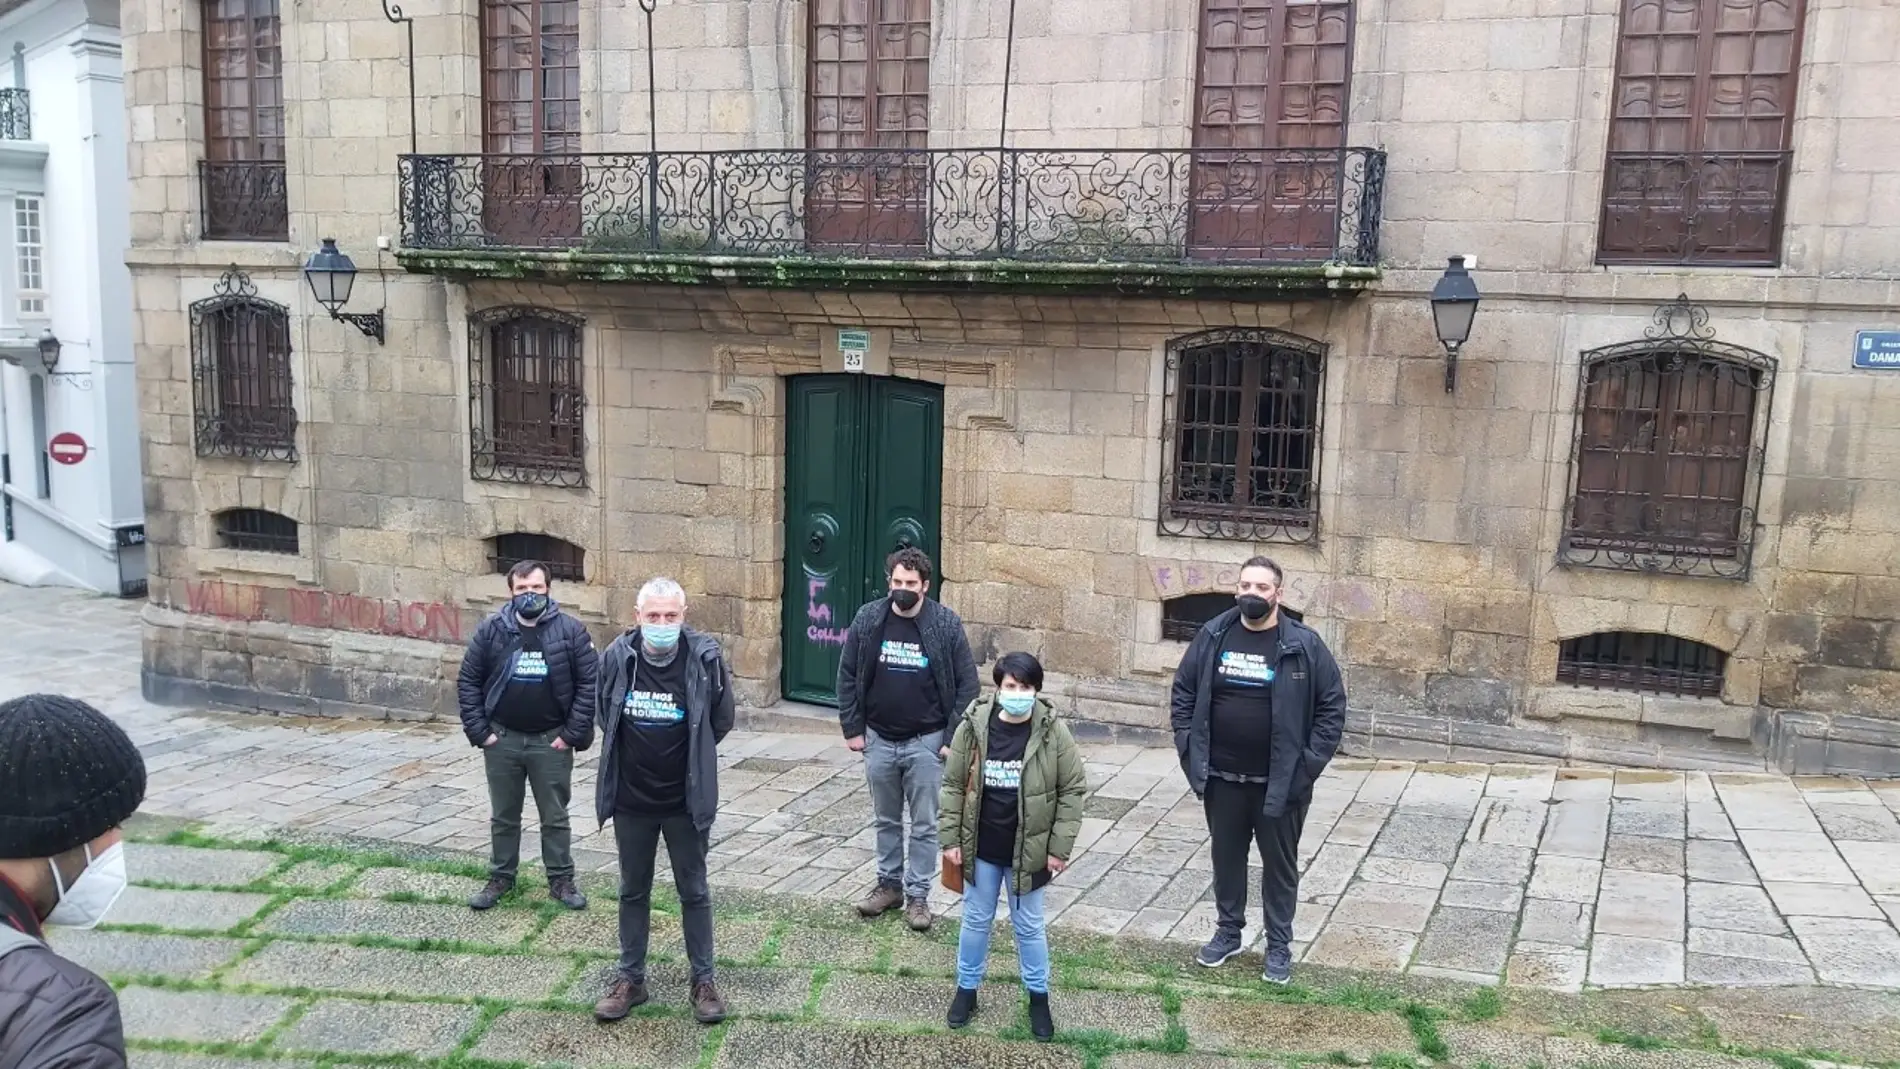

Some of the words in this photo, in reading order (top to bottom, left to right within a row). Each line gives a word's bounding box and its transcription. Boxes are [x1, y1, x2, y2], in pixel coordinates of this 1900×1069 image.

[846, 353, 860, 366] 25
[632, 690, 651, 701] QUE
[652, 692, 673, 702] NOS
[626, 699, 677, 711] DEVOLVAN
[985, 760, 1002, 769] QUE
[1003, 760, 1021, 769] NOS
